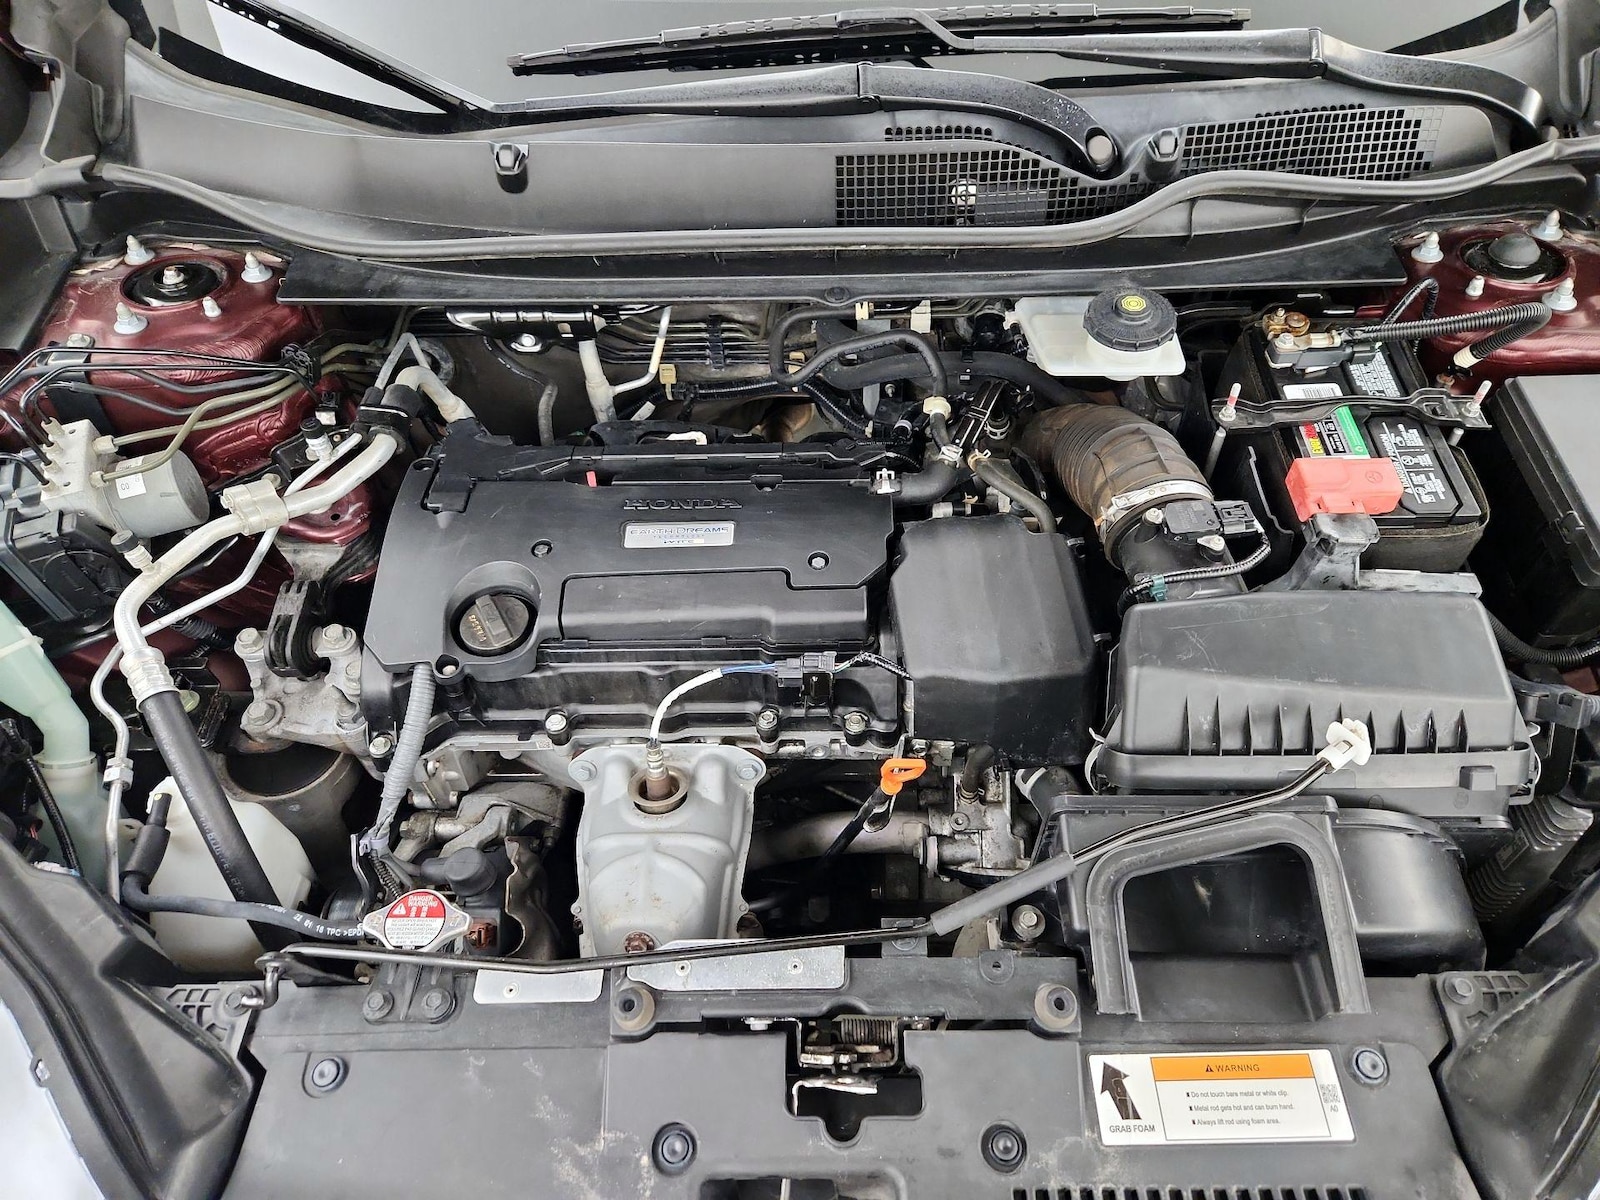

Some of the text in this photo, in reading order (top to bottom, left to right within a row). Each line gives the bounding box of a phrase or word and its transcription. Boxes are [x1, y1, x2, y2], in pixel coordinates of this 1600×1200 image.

[623, 499, 742, 511] HONDA
[676, 526, 730, 534] DREAMS
[327, 927, 341, 937] TPC
[1215, 1063, 1260, 1073] WARNING
[1210, 1090, 1225, 1098] touch
[1278, 1089, 1288, 1097] clip.
[1220, 1104, 1232, 1112] gets
[1236, 1118, 1250, 1126] using
[1109, 1124, 1156, 1133] GRAB FOAM
